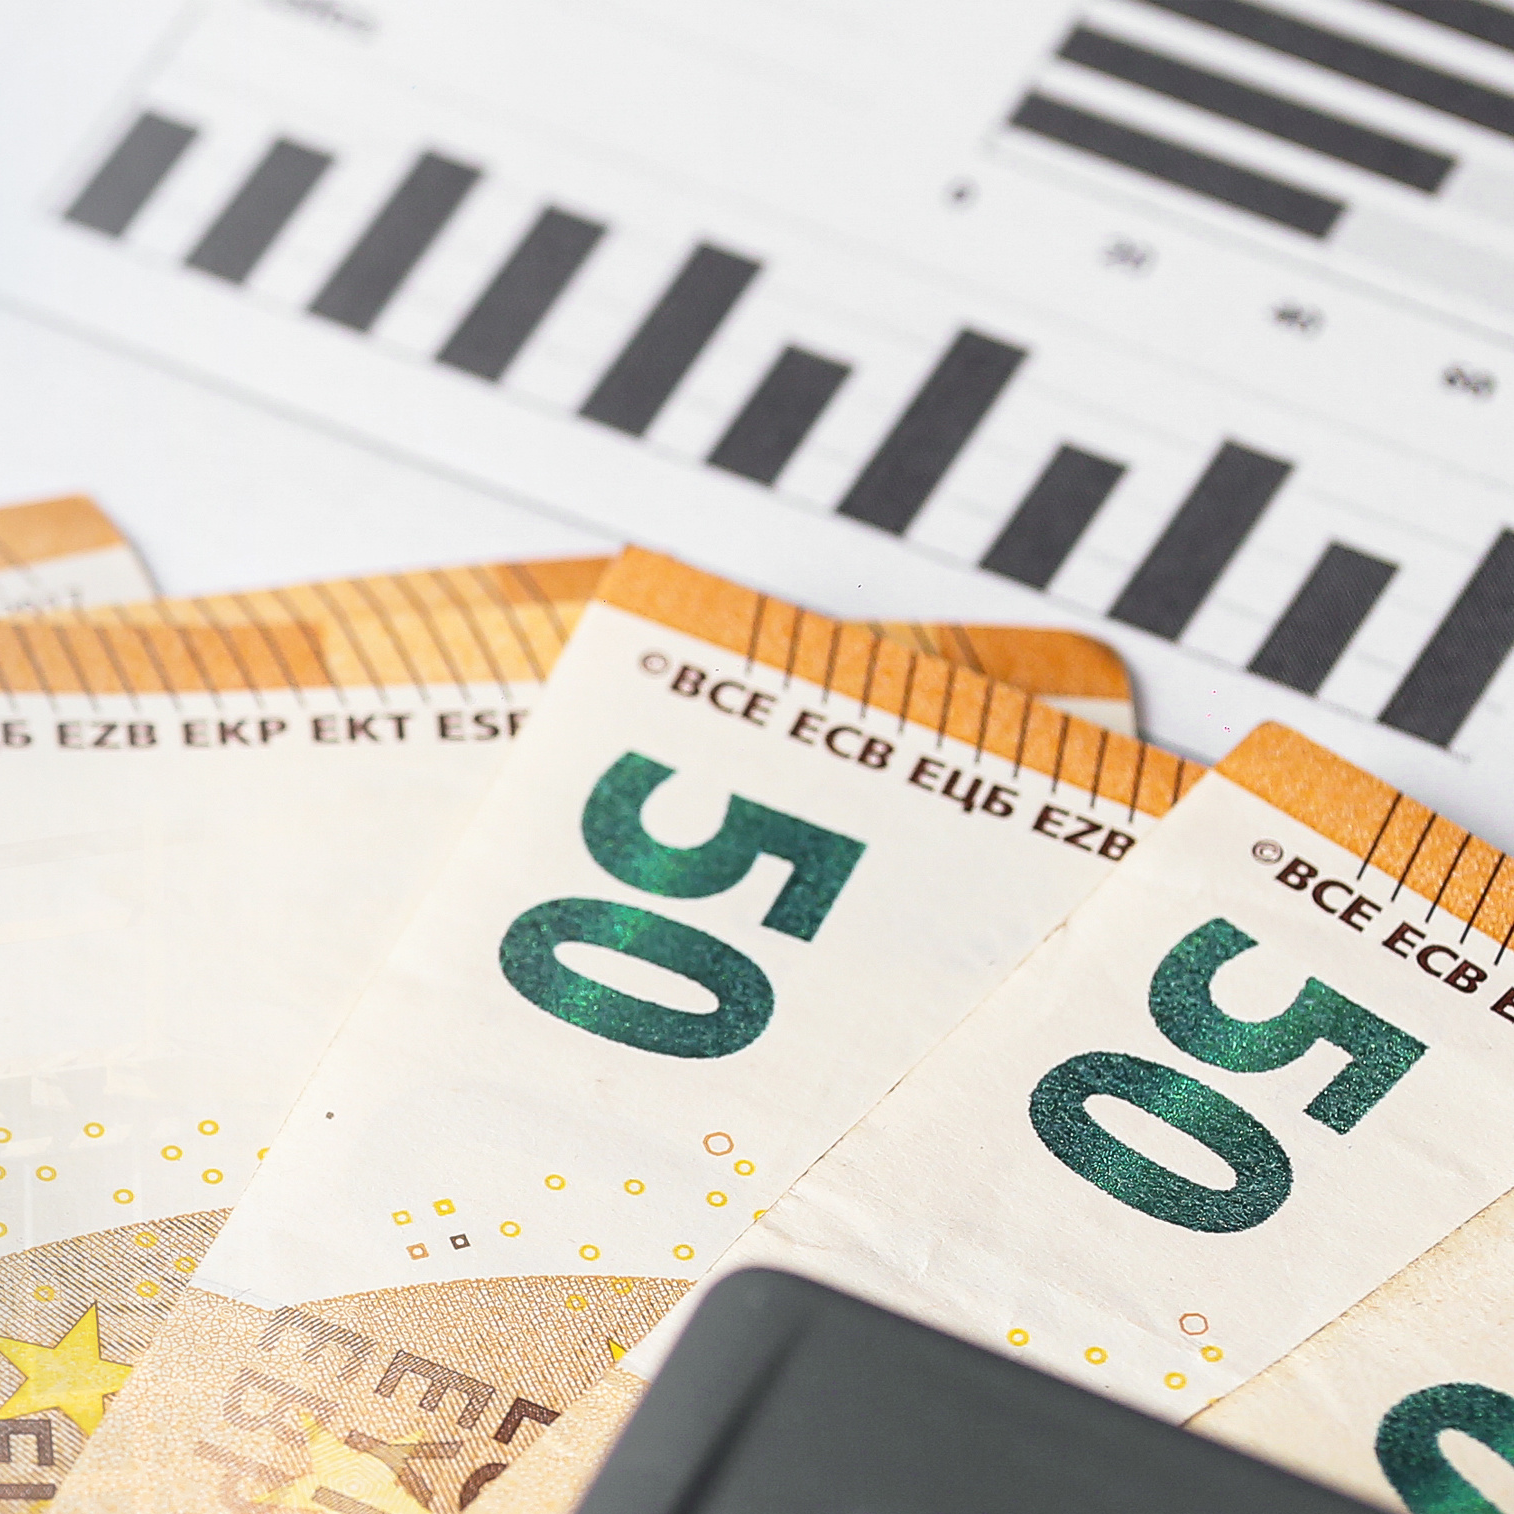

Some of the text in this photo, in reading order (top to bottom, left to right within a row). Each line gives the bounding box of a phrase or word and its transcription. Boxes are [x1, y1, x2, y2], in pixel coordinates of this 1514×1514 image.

[56, 721, 158, 749] EZB
[182, 716, 287, 747] EKP
[310, 712, 415, 744] EKT
[788, 710, 895, 771] ECB
[907, 755, 1020, 815] ЕЦБ
[1031, 805, 1137, 863] EZB
[498, 751, 867, 1059] 50
[1382, 921, 1488, 994] ECB
[1030, 917, 1429, 1234] 50
